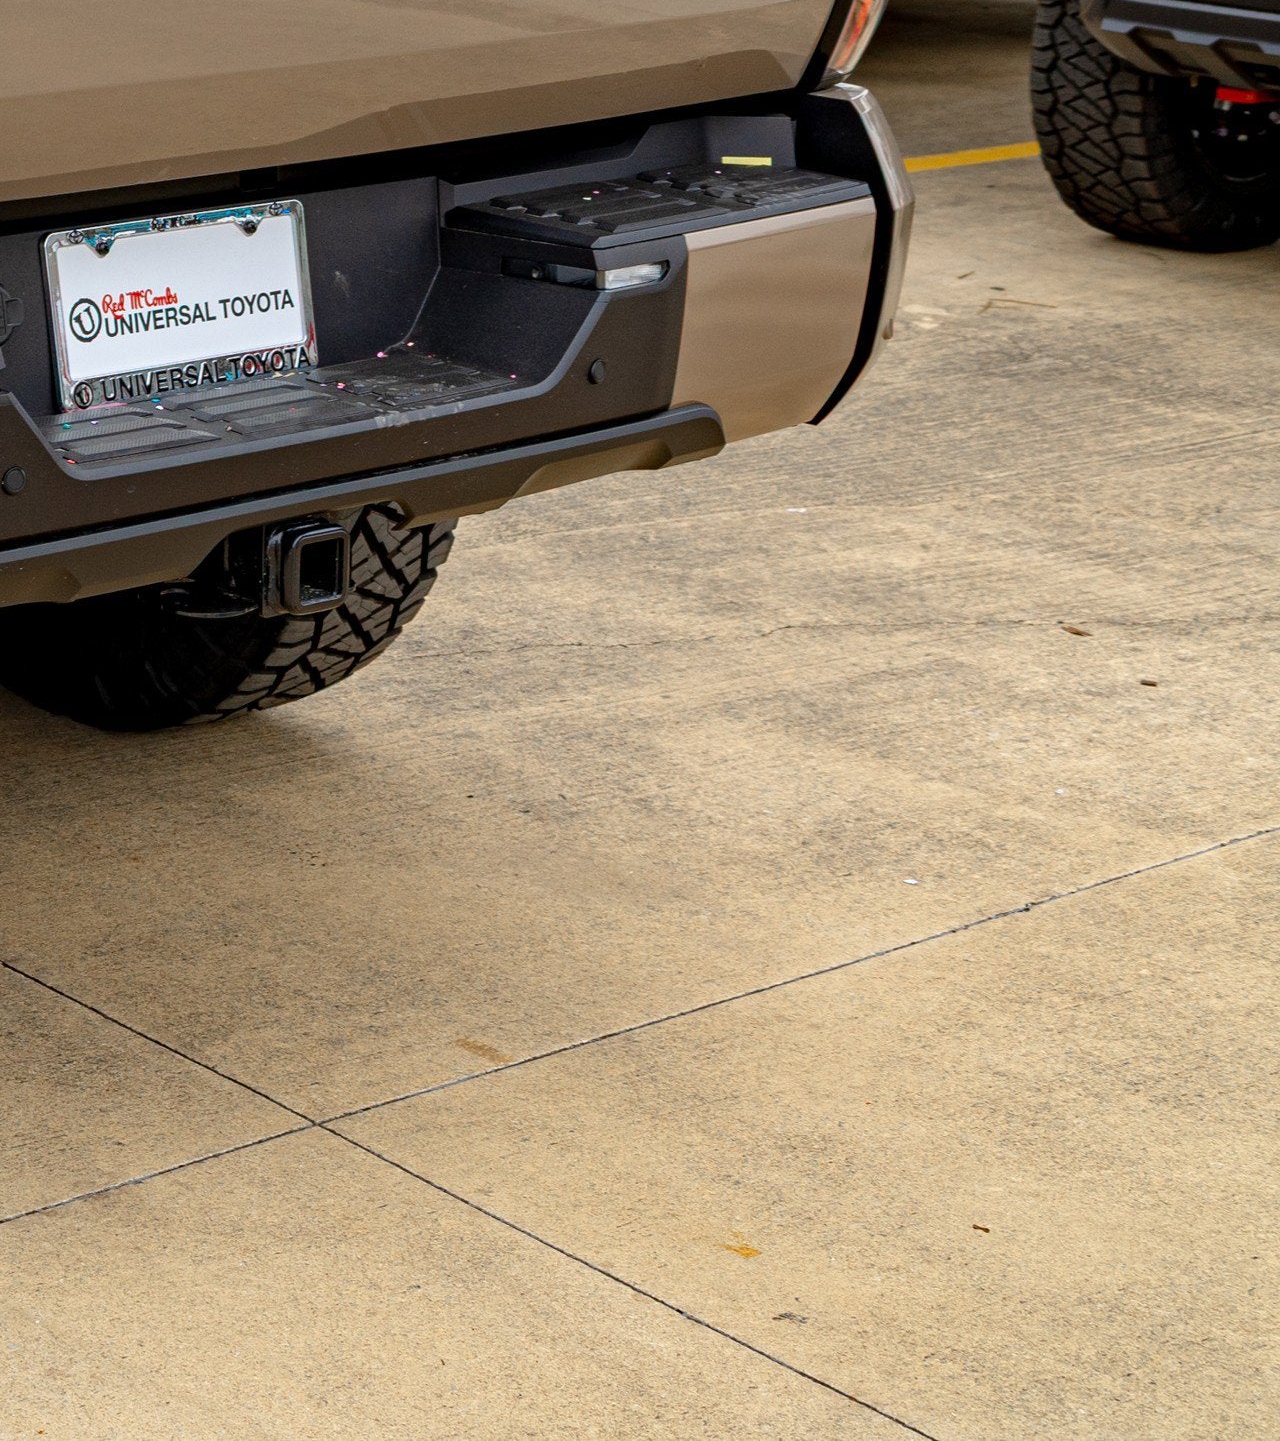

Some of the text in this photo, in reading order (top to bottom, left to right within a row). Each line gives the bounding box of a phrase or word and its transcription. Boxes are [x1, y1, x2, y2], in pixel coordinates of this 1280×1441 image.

[101, 292, 125, 319] Red
[104, 302, 217, 338] UNIVERSAL
[218, 288, 295, 321] TOYOTA
[100, 362, 226, 401] UNIVERSAL
[227, 346, 312, 379] TOYOTA
